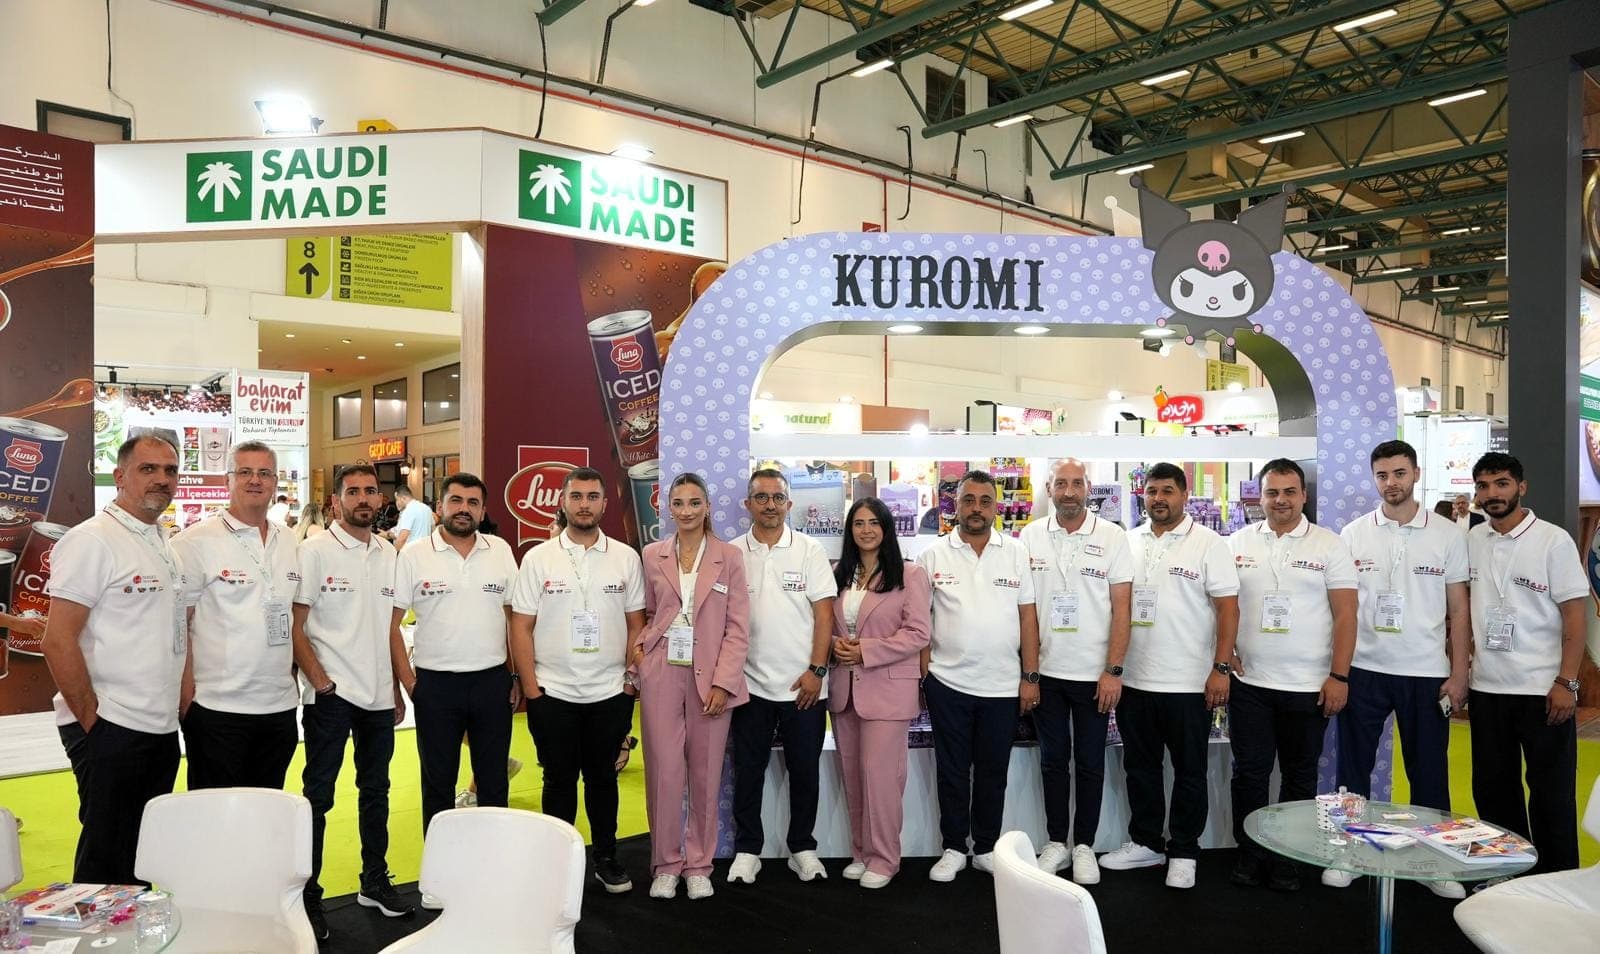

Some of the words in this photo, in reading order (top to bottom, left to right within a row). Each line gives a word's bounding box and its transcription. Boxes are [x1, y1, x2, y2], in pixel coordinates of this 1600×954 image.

[261, 145, 387, 182] SAUDI
[590, 162, 694, 212] SAUDI
[260, 184, 387, 220] MADE
[589, 201, 694, 247] MADE
[304, 241, 315, 258] 8
[832, 254, 1044, 311] KUROMI
[615, 347, 638, 362] Luna
[237, 376, 306, 401] baharat
[605, 368, 661, 399] ICED
[250, 398, 292, 414] evim
[783, 412, 832, 424] natural
[9, 447, 38, 461] Luna
[0, 470, 51, 493] CED
[178, 475, 204, 484] ahve
[0, 492, 40, 504] OFFEE
[806, 527, 831, 535] KUROMI
[19, 591, 50, 606] COFF
